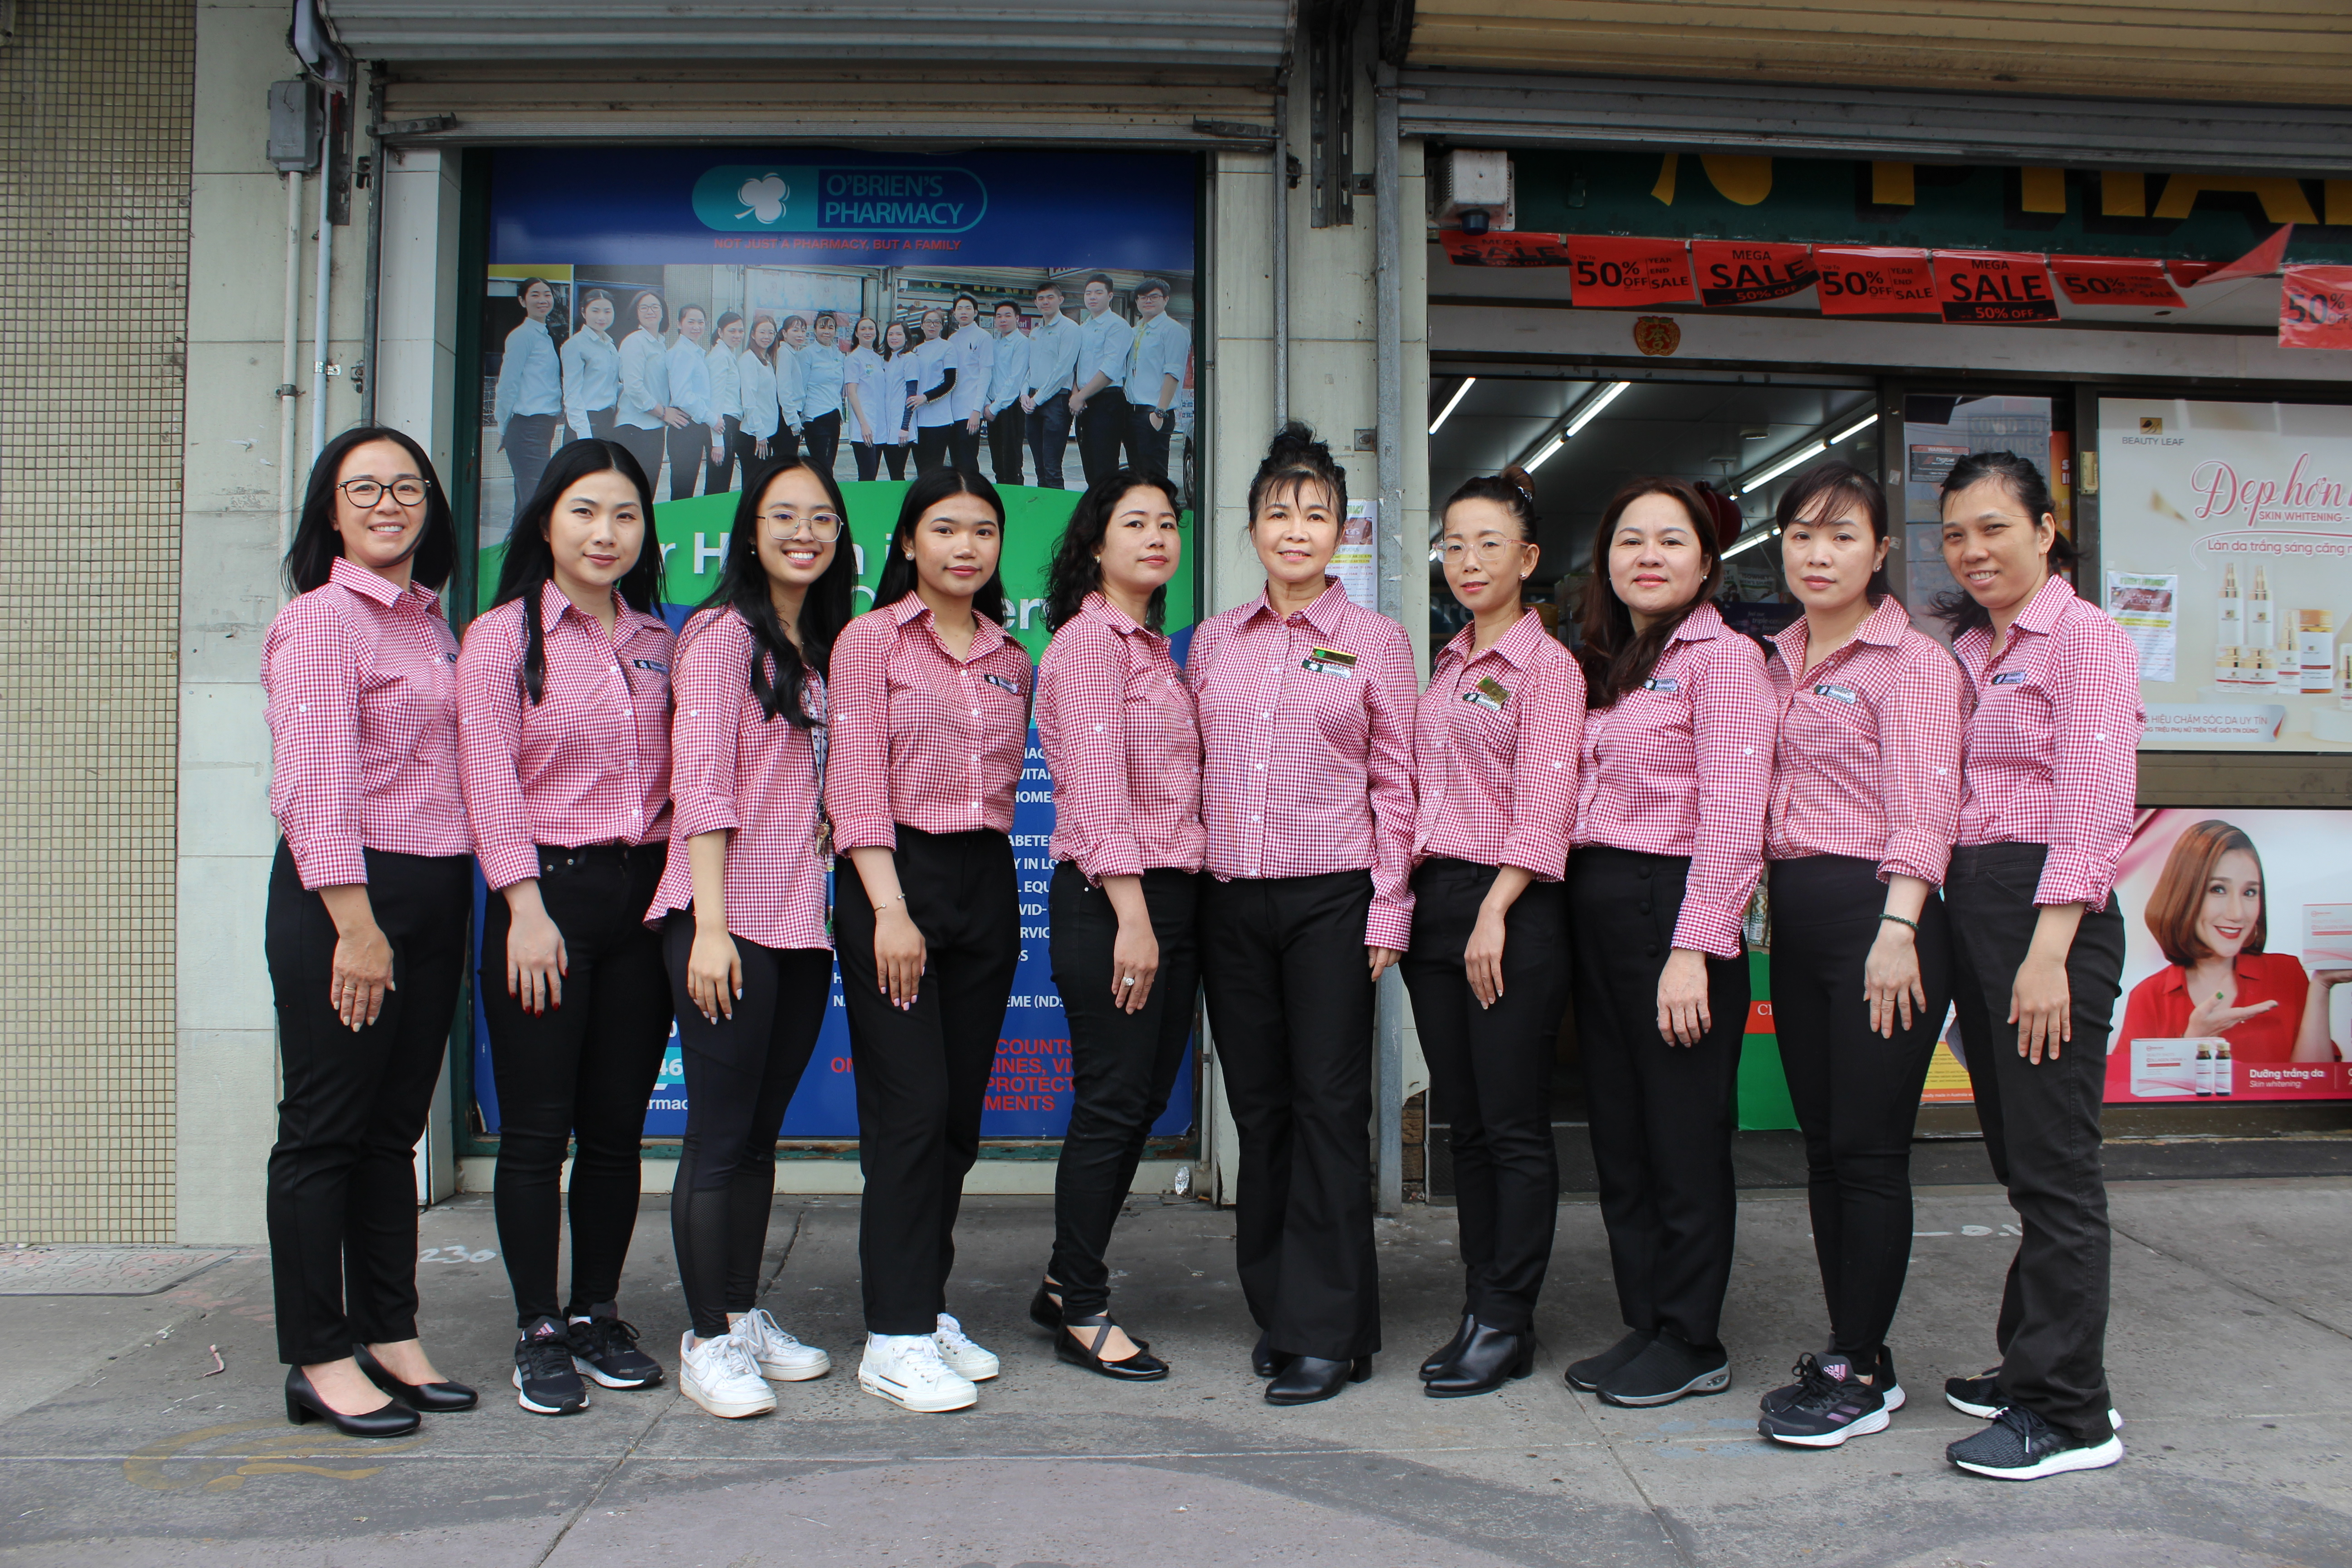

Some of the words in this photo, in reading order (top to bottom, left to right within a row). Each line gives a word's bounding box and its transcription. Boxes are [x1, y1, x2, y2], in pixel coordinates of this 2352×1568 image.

[827, 175, 943, 197] O'BRIEN'S
[825, 202, 964, 224] PHARMACY
[715, 239, 741, 249] NOT
[745, 239, 778, 249] JUST
[781, 239, 789, 249] A
[794, 239, 869, 251] PHARMACY,
[873, 240, 900, 250] BUT
[902, 240, 911, 250] A
[916, 240, 961, 250] FAMILY
[1460, 245, 1560, 258] SALE
[1732, 250, 1772, 260] MEGA
[1972, 260, 2010, 270] MEGA
[1710, 260, 1808, 288] SALE
[1623, 277, 1648, 286] OFF
[1651, 276, 1689, 289] SALE
[1951, 273, 2047, 301] SALE
[1736, 290, 1771, 301] 50%
[1775, 285, 1797, 295] OFF
[1869, 286, 1892, 295] OFF
[1896, 288, 1933, 300] SALE
[1975, 307, 2009, 318] 50%
[2012, 309, 2034, 317] OFF
[2122, 436, 2159, 446] BEAUTY
[2161, 438, 2185, 446] LEAF
[2259, 511, 2282, 520] SKIN
[2285, 511, 2342, 522] WHITENING
[2208, 539, 2229, 551] Làn
[2231, 540, 2247, 552] da
[2284, 541, 2313, 556] sáng
[2315, 542, 2346, 557] căng
[2203, 714, 2223, 725] SÓC
[2225, 716, 2237, 725] DA
[2239, 716, 2251, 725] UY
[1019, 768, 1051, 780] VITA
[1014, 791, 1053, 803] HOME
[1024, 858, 1039, 870] IN
[1041, 858, 1059, 870] LO
[1024, 881, 1050, 893] EQU
[1019, 904, 1047, 916] VID-
[1020, 926, 1050, 939] RVIC
[1006, 995, 1031, 1008] EME
[995, 1038, 1072, 1055] COUNTS
[990, 1058, 1047, 1076] INES,
[2311, 1068, 2324, 1078] da
[985, 1076, 1074, 1092] PROTECT
[2266, 1080, 2302, 1089] whitening
[647, 1098, 688, 1110] rmac
[985, 1095, 1055, 1111] MENTS
